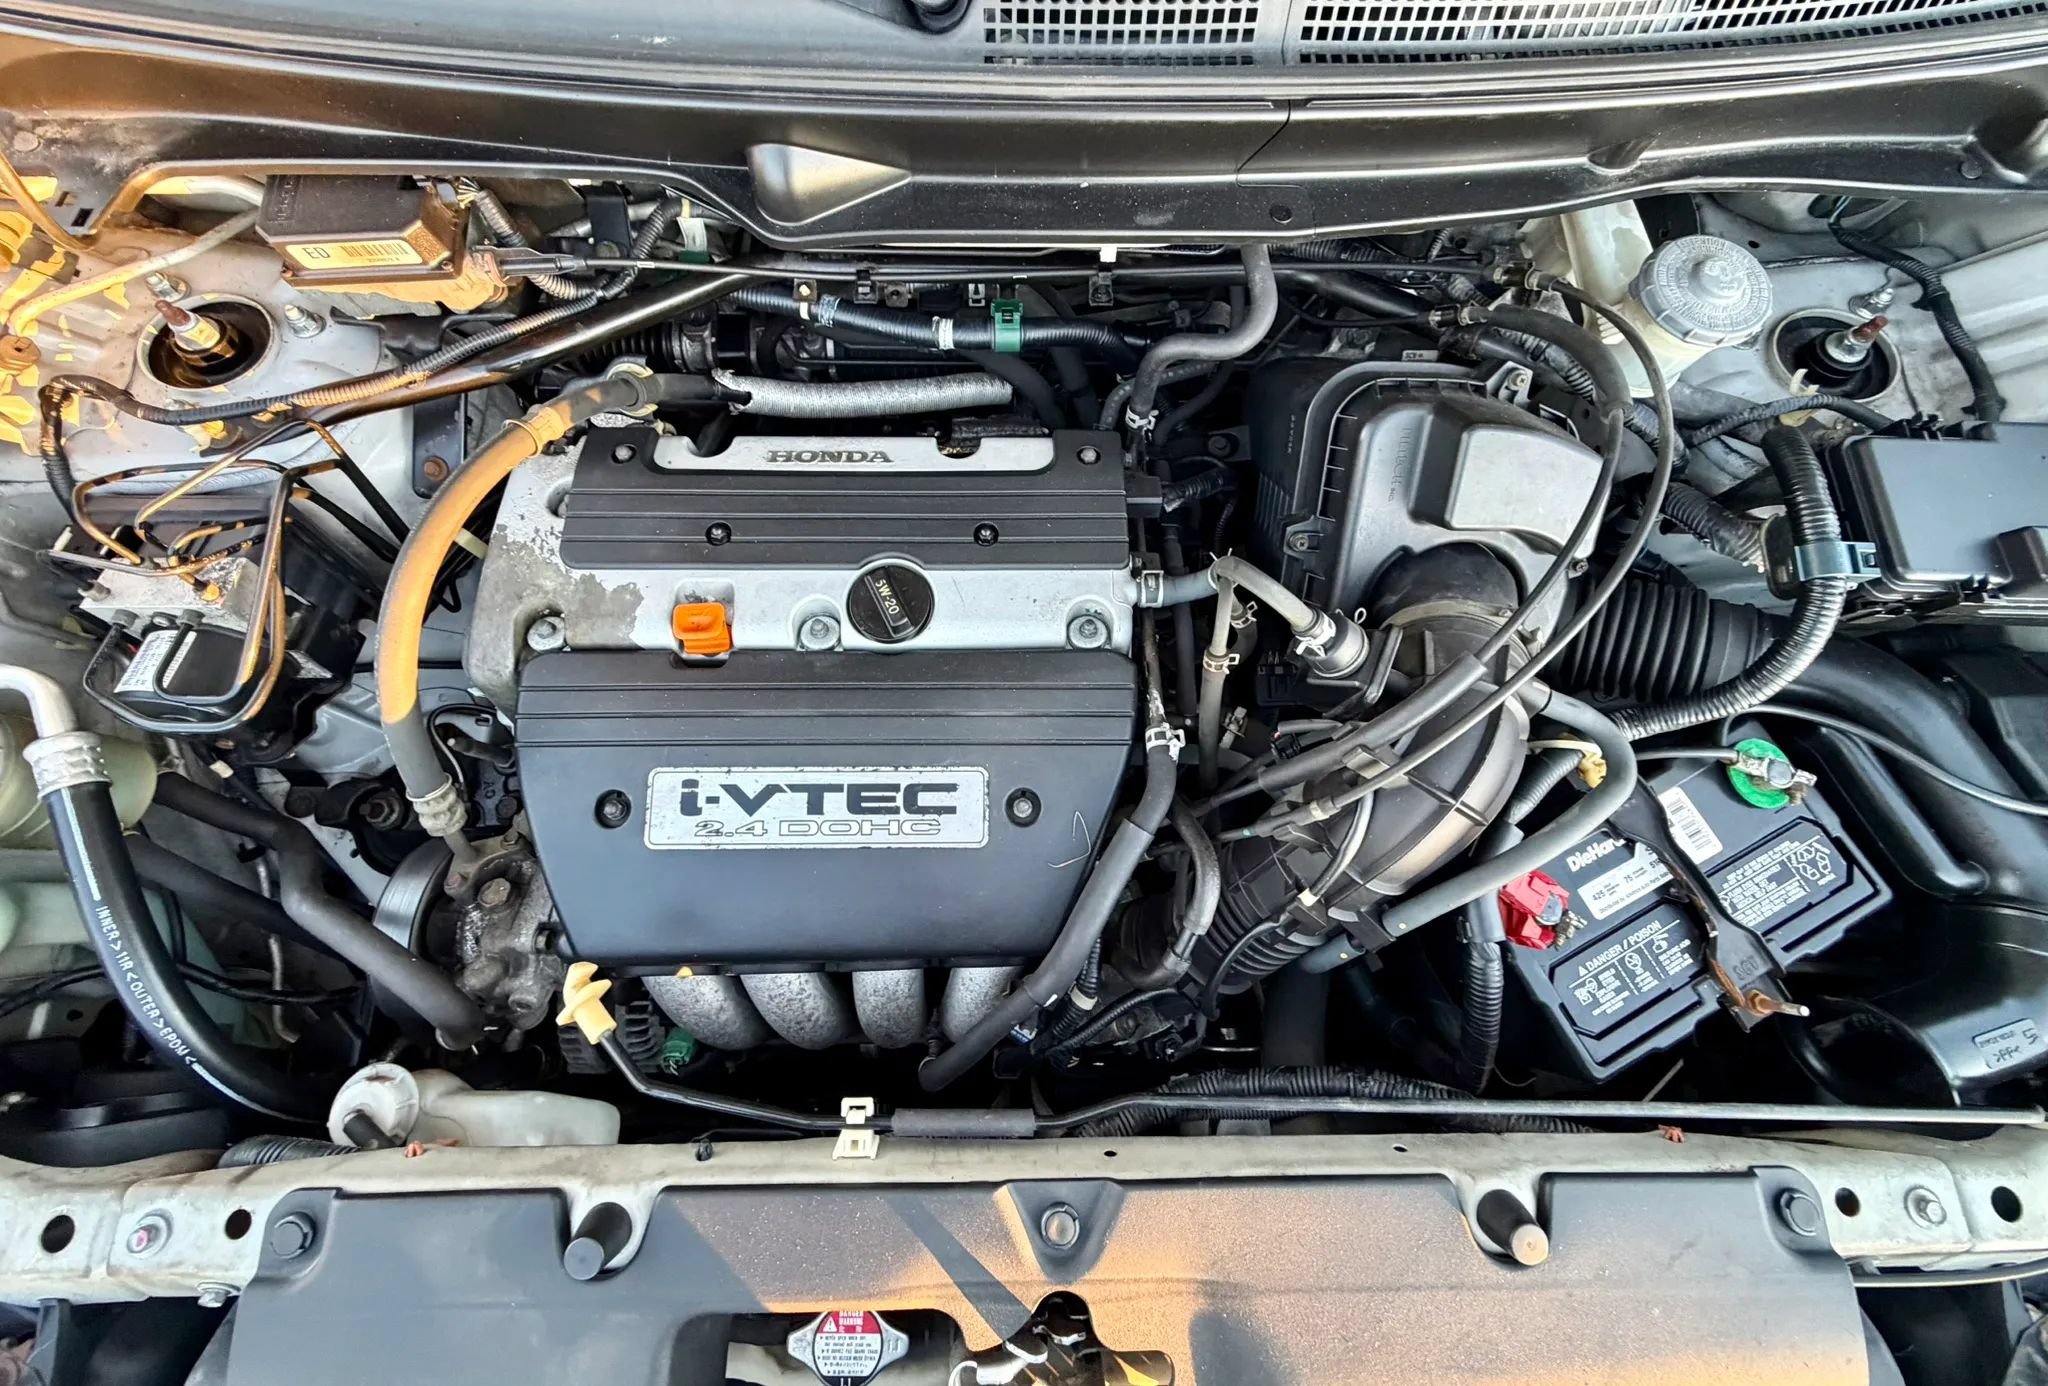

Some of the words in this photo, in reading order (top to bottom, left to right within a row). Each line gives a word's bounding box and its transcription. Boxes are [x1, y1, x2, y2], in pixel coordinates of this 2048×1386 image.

[302, 247, 330, 259] ED
[767, 450, 893, 464] HONDA
[874, 578, 900, 615] 5W-20
[680, 778, 960, 817] i-VTEC
[694, 820, 768, 837] 2.4
[779, 819, 941, 837] DOHC
[1586, 945, 1623, 970] DANGER
[1628, 921, 1661, 945] POISON
